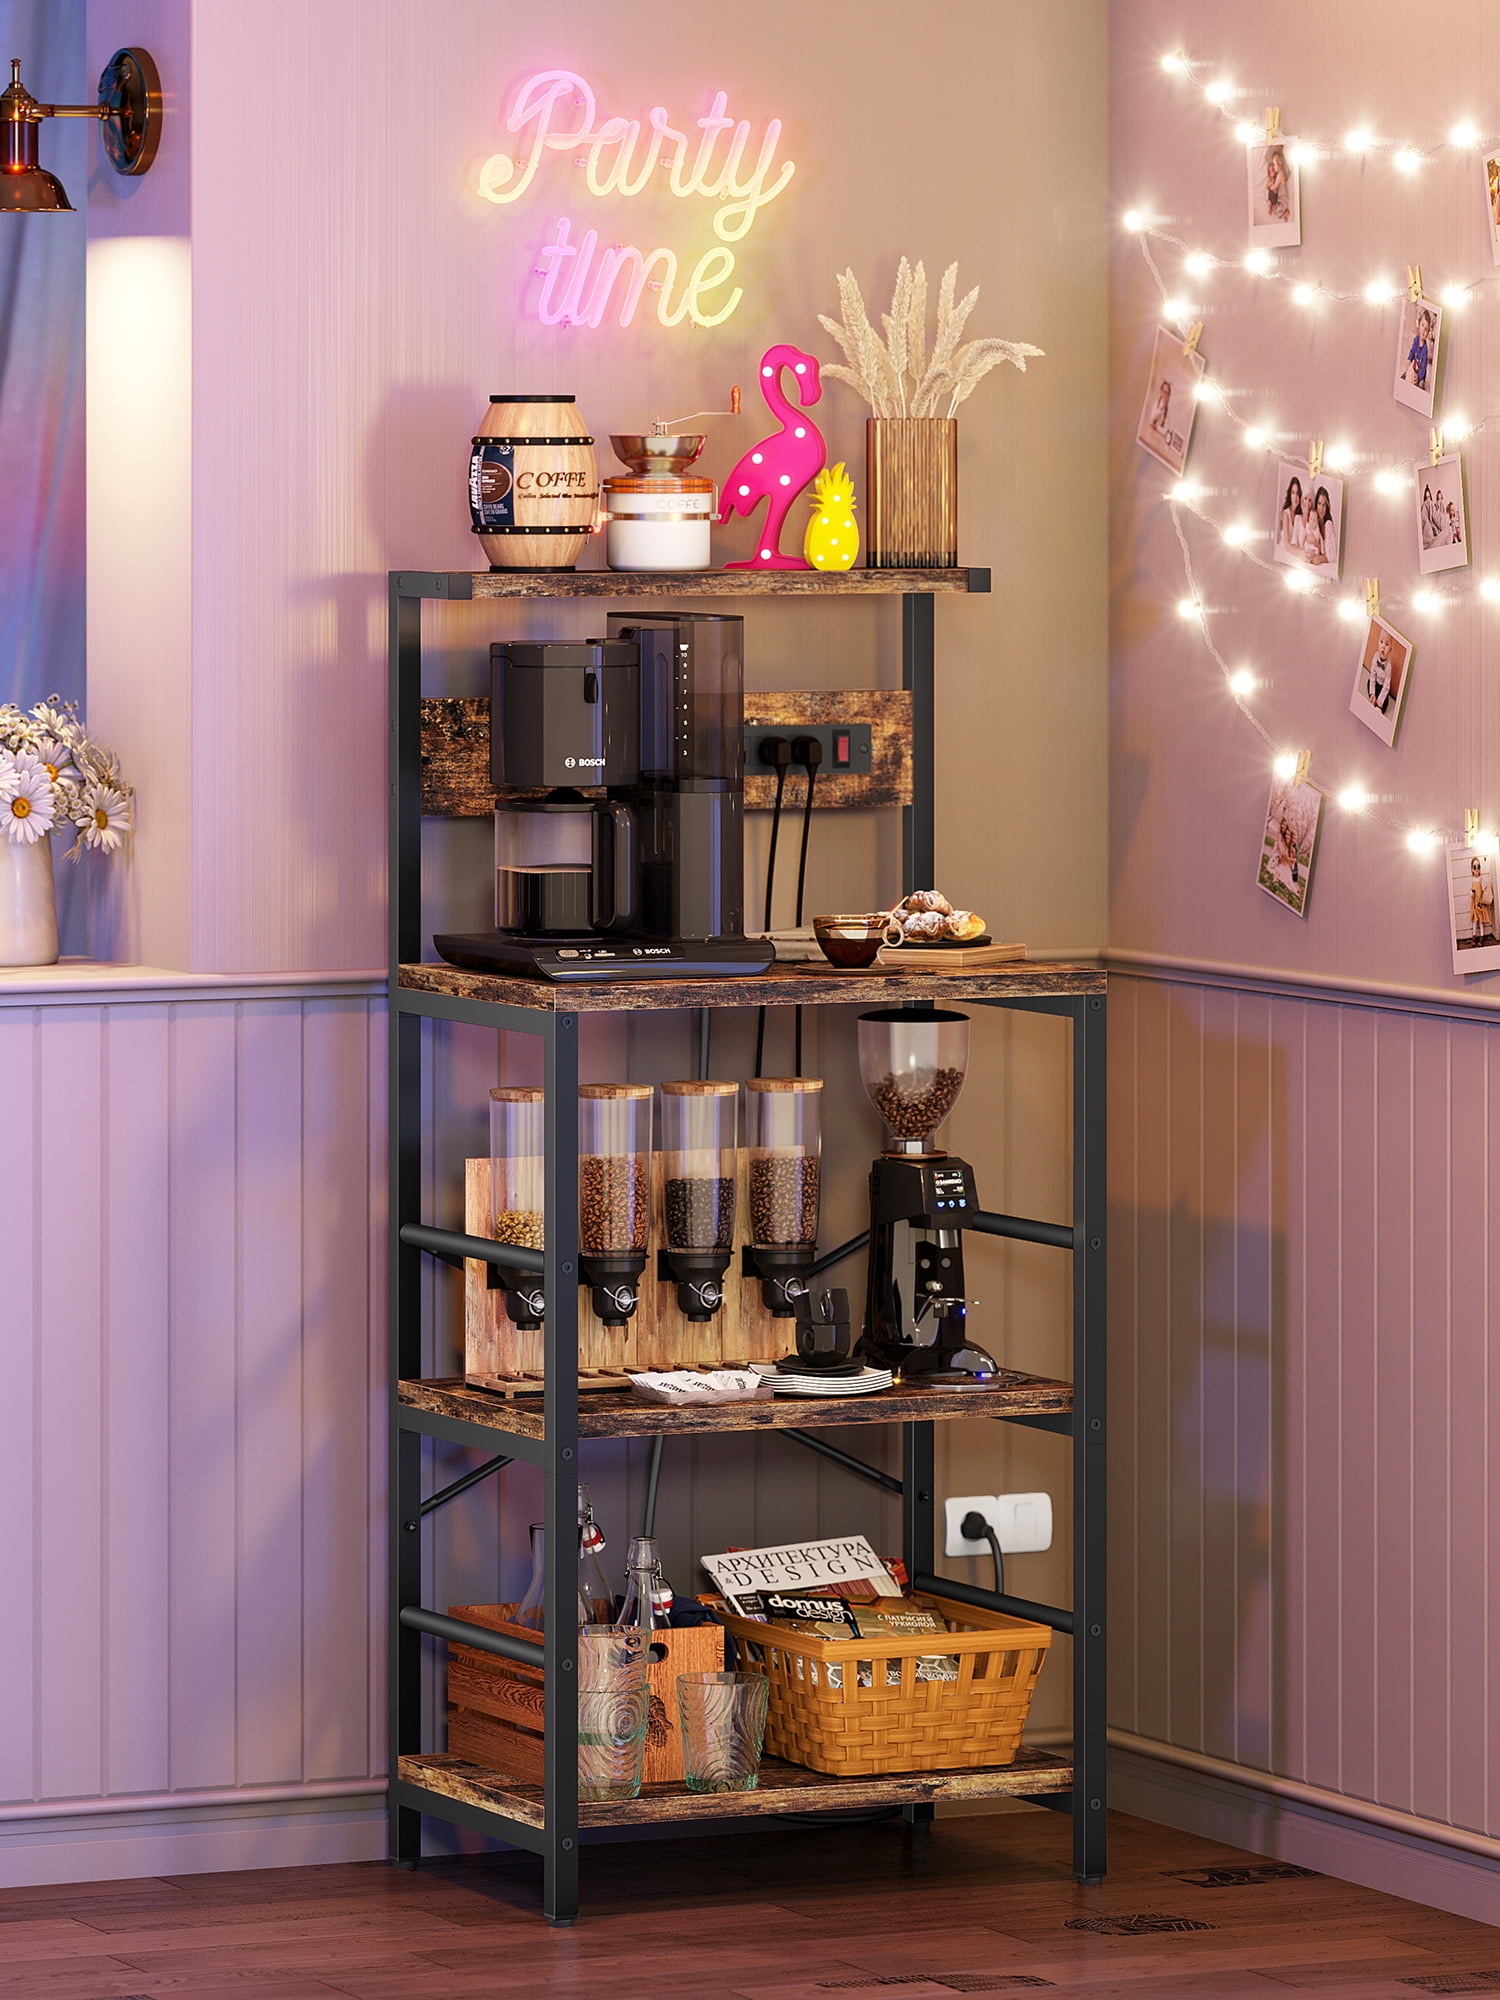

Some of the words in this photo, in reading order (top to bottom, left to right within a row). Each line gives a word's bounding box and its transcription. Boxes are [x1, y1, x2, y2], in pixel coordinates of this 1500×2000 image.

[478, 70, 795, 242] Party
[539, 217, 743, 328] time
[516, 471, 586, 490] COFFE
[578, 758, 606, 767] BOSCH
[717, 1541, 871, 1573] АРХИТЕКТУРА
[733, 1556, 875, 1587] DESIGN
[768, 1594, 844, 1611] domus
[796, 1605, 854, 1624] design
